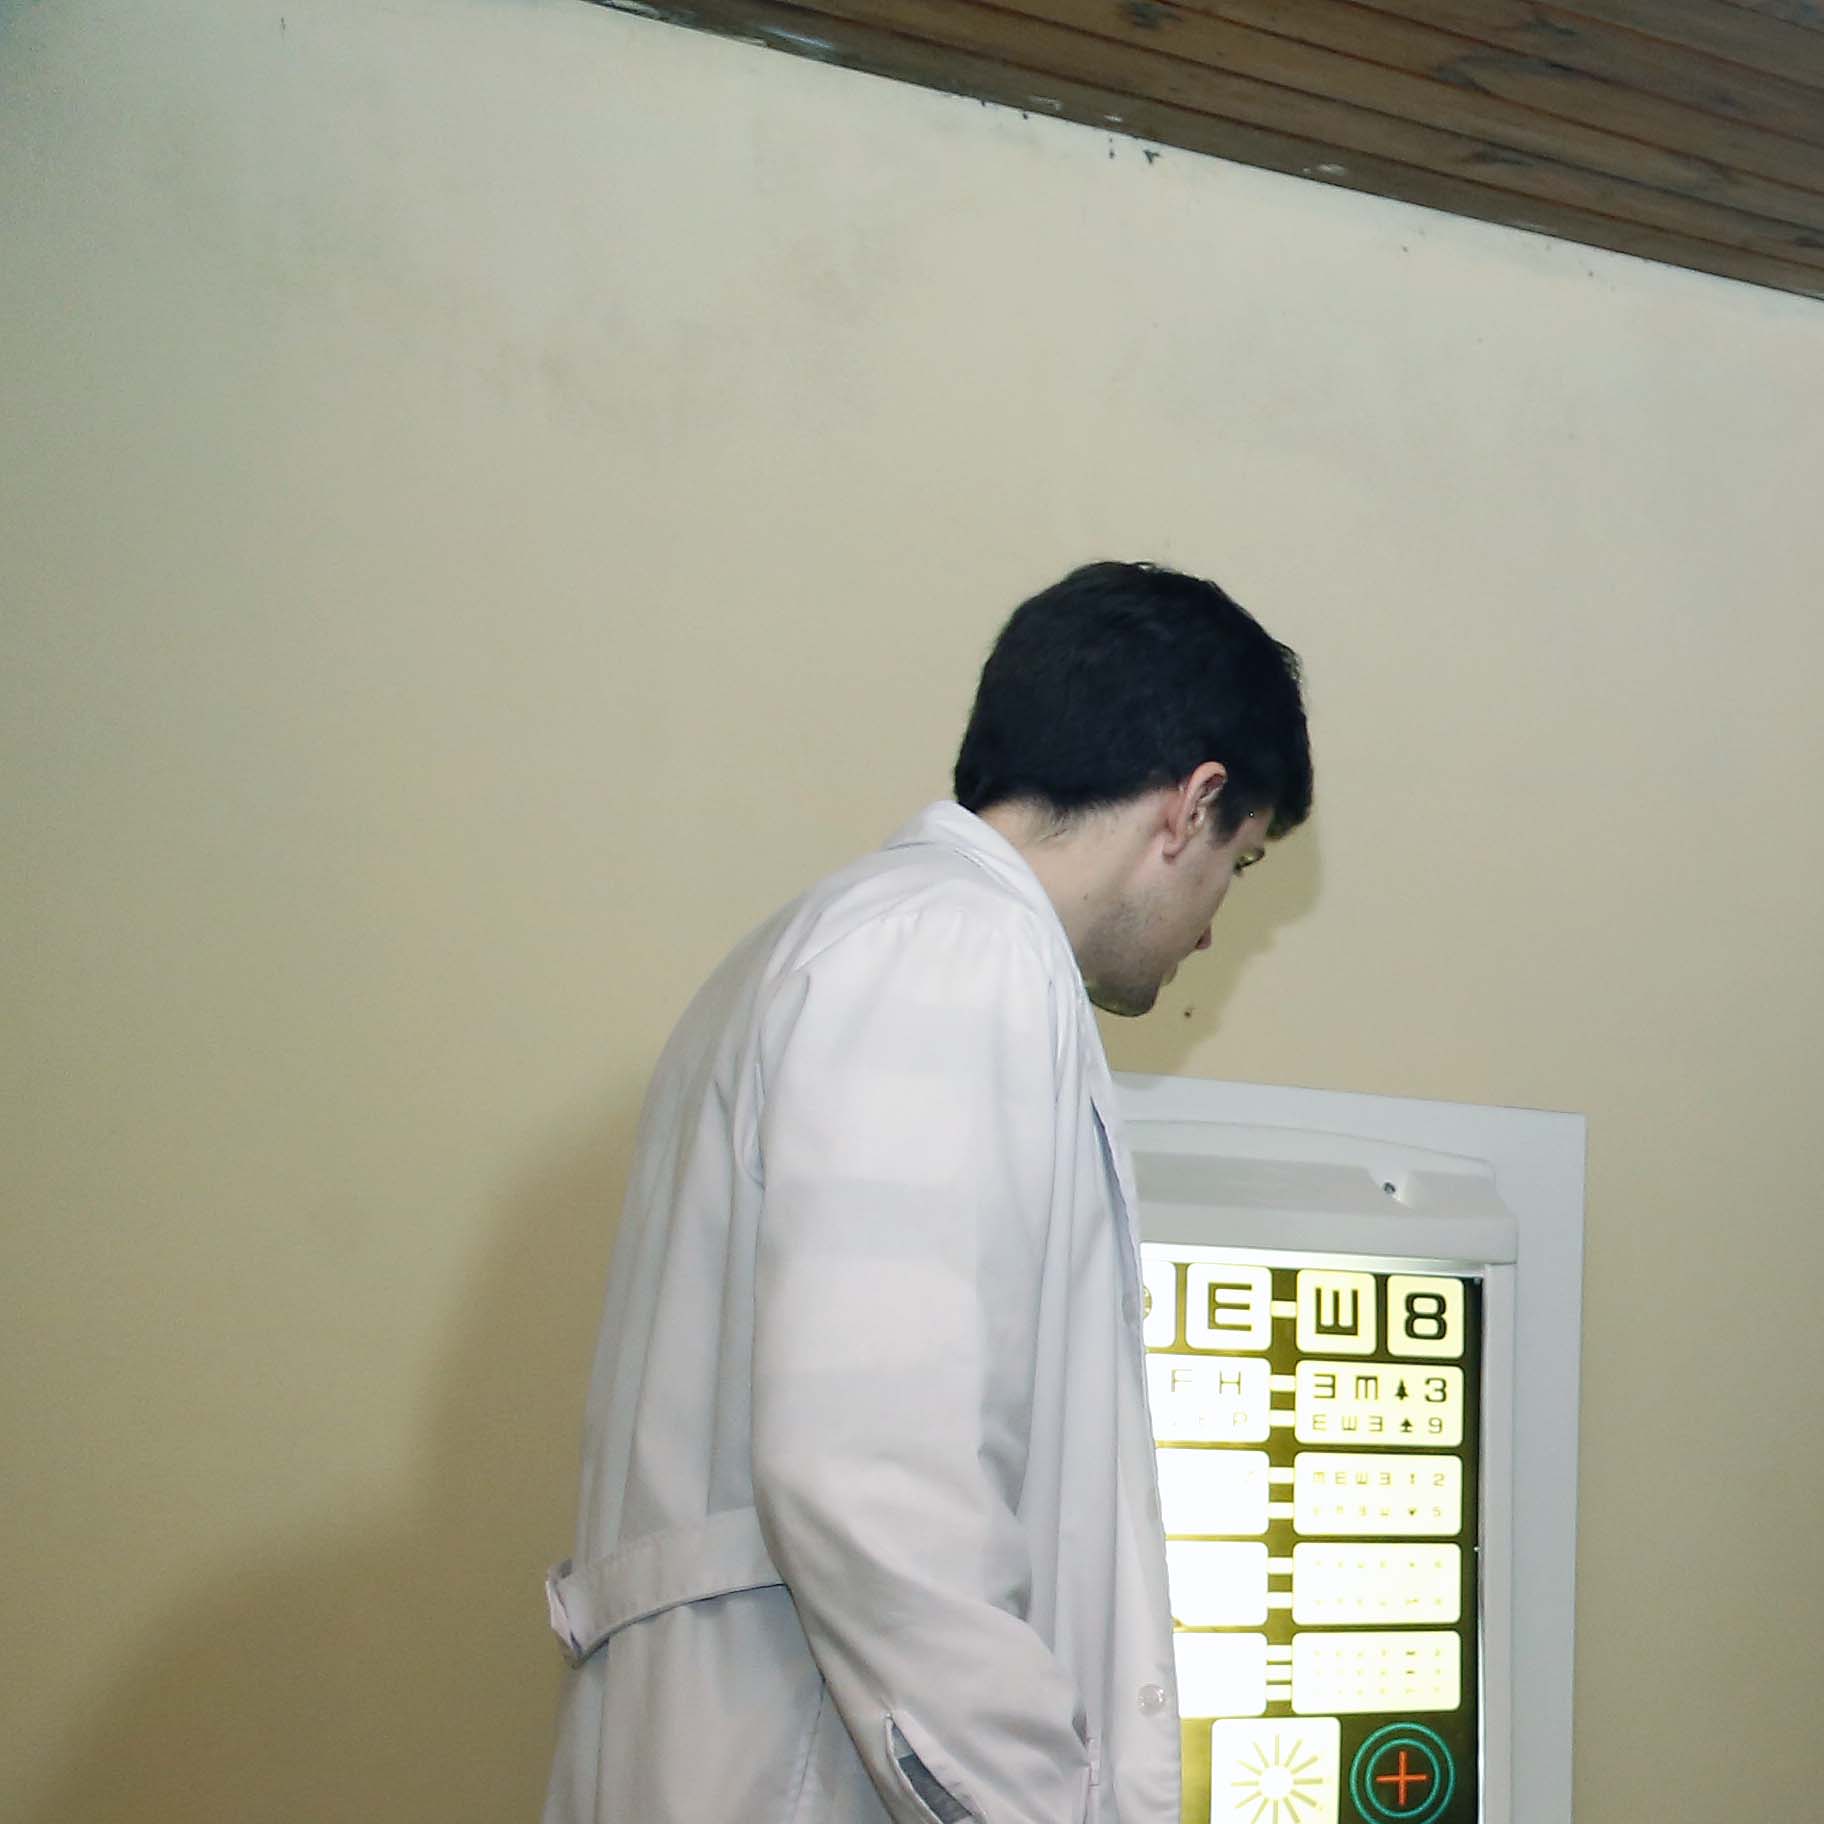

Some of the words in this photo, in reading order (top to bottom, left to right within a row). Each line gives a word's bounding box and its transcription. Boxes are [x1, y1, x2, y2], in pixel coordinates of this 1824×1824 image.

[1208, 1282, 1252, 1331] E
[1405, 1292, 1447, 1340] 8
[1219, 1370, 1241, 1395] H
